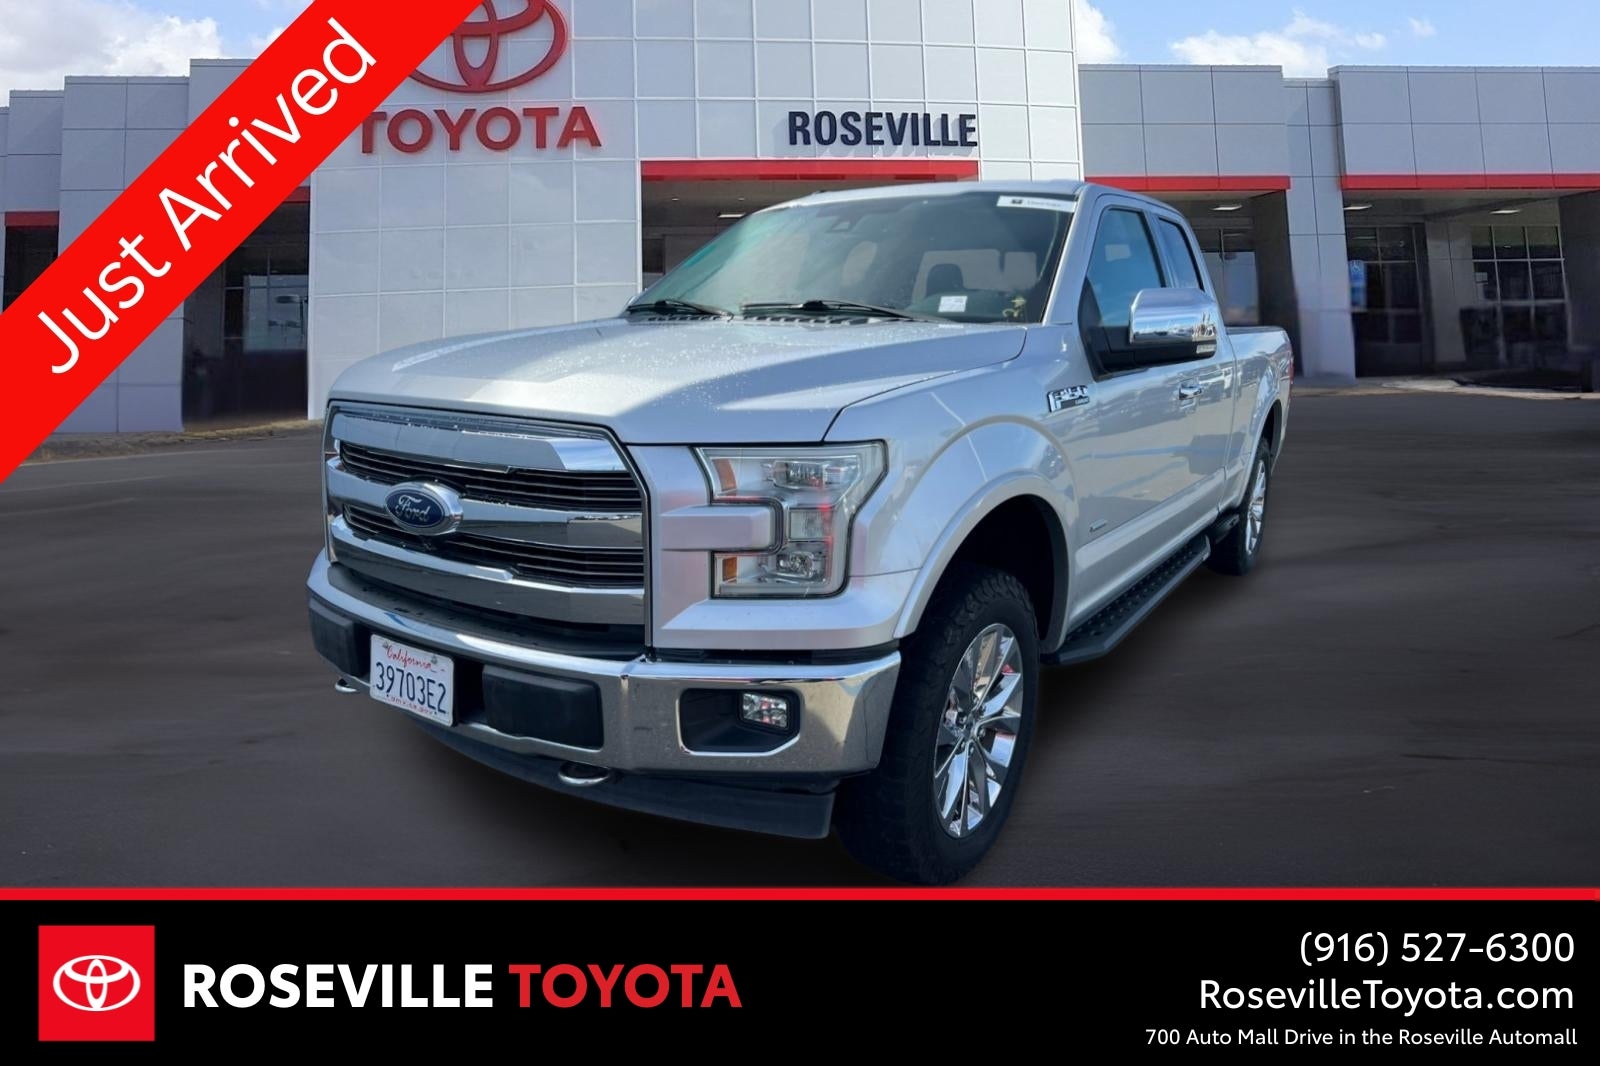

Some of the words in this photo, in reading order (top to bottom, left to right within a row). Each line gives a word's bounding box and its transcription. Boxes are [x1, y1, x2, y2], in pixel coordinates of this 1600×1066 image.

[361, 106, 602, 154] TOYOTA
[788, 110, 978, 147] ROSEVILLE
[395, 494, 431, 522] Ford
[376, 661, 447, 714] 39703E2
